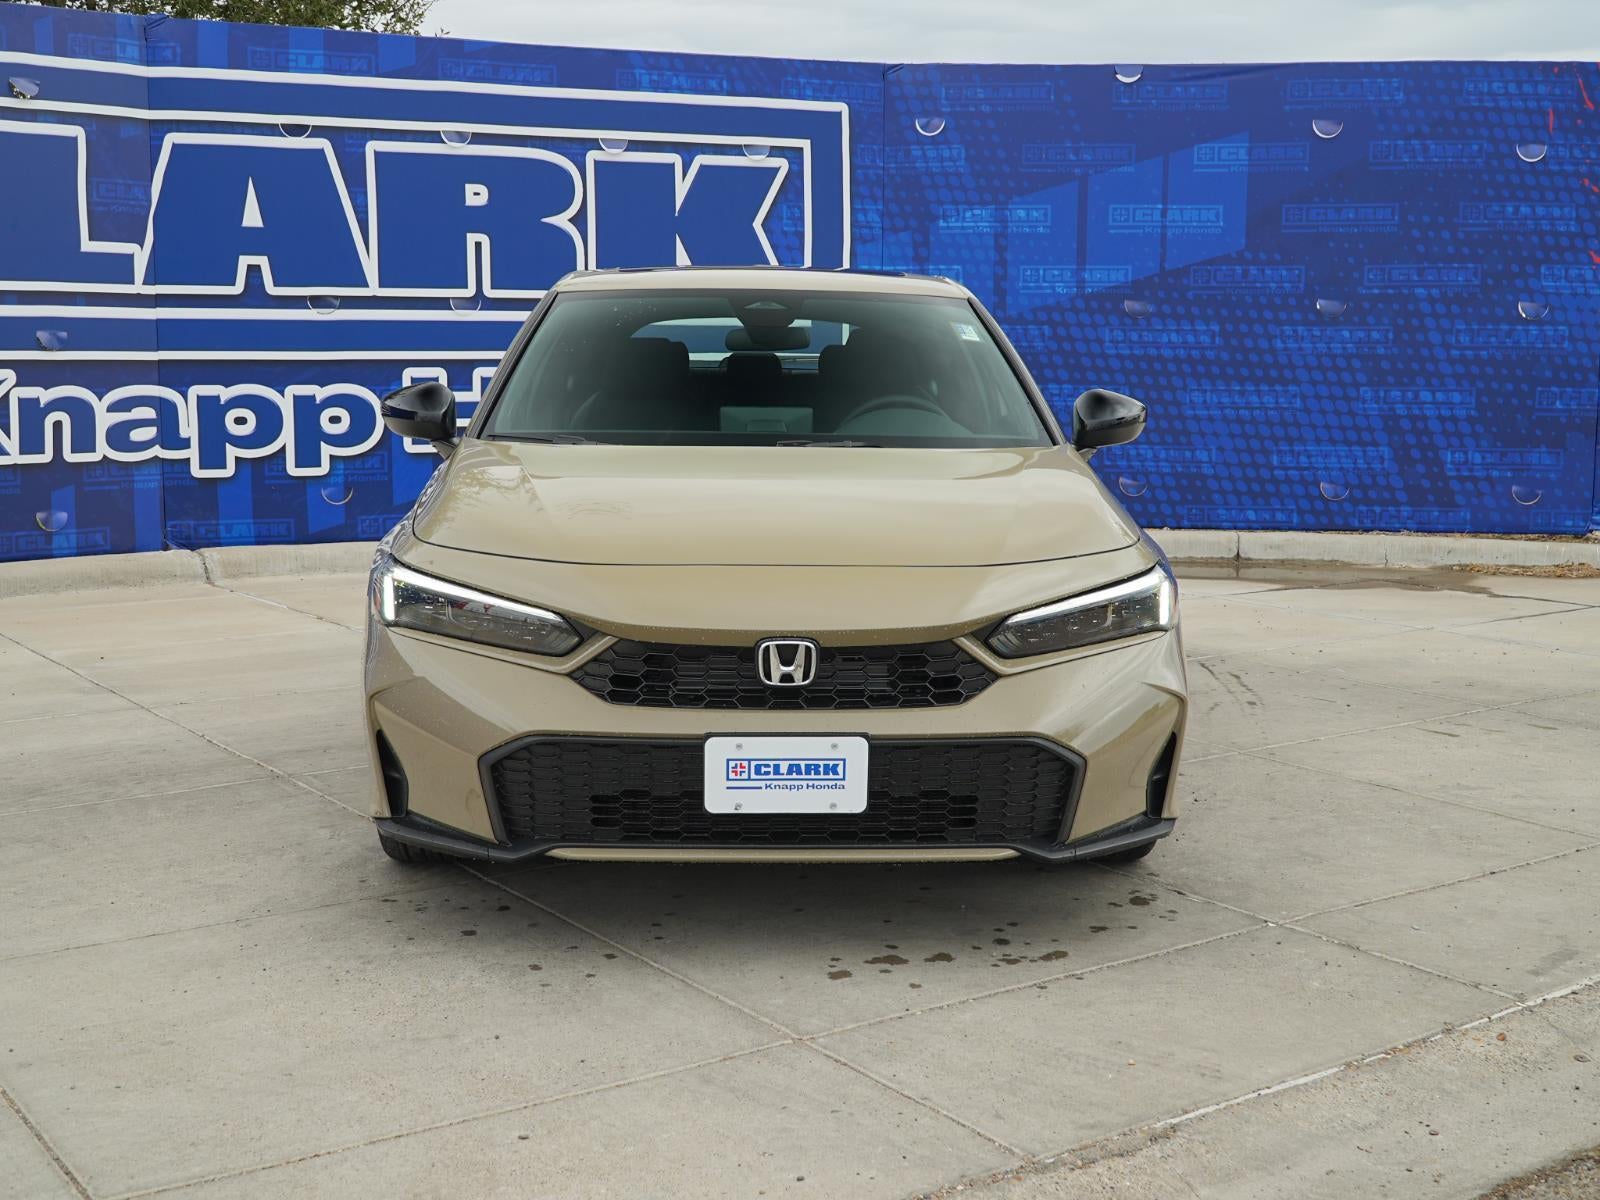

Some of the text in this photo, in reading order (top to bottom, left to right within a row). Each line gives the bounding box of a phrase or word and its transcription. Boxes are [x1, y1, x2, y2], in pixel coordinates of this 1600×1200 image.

[1219, 147, 1304, 160] CLARK
[1134, 208, 1218, 221] CLARK
[1308, 207, 1393, 220] CLARK
[753, 763, 841, 777] CLARK
[764, 782, 846, 792] Knapp Honda
